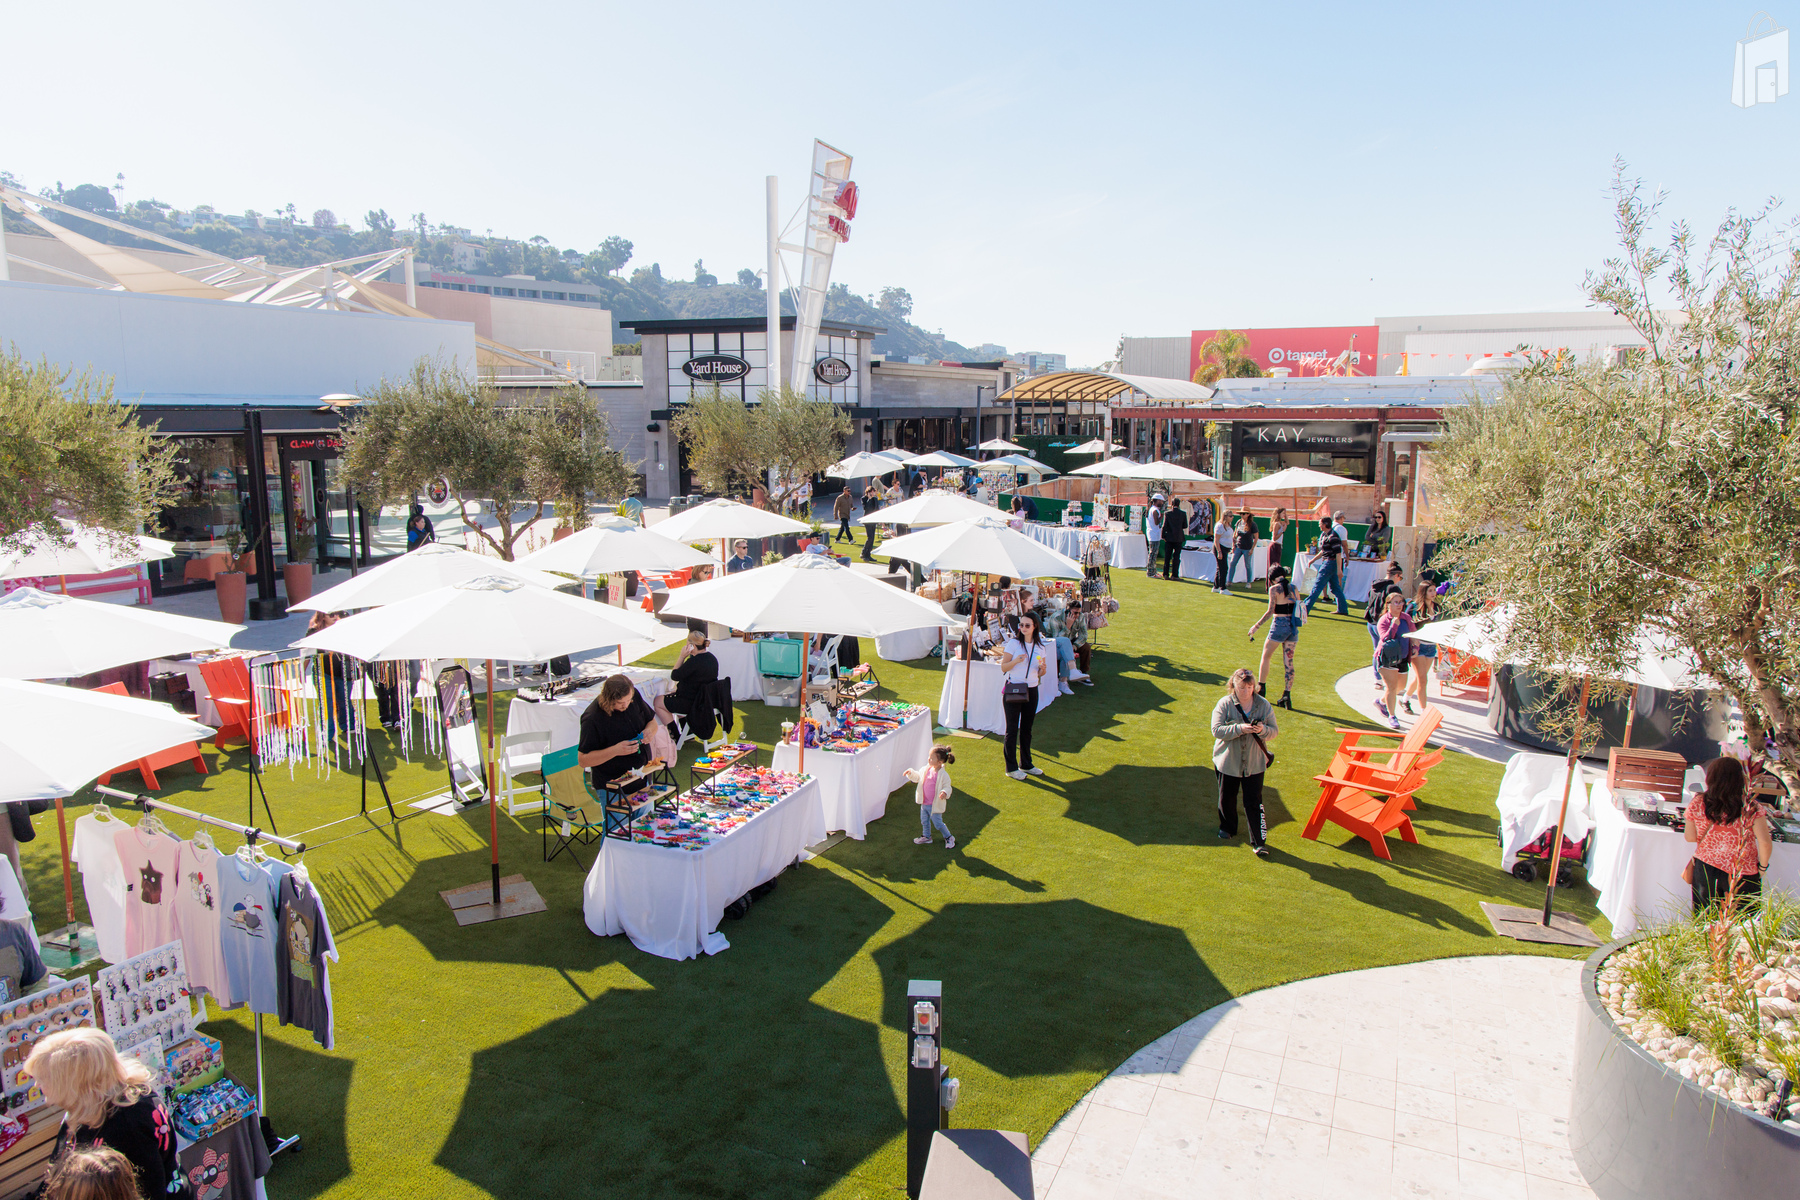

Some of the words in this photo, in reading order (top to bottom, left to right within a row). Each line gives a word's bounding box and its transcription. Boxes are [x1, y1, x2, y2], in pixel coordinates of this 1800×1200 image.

[431, 272, 476, 284] Sheraton
[1286, 349, 1328, 363] target
[688, 361, 711, 375] Yard
[712, 361, 742, 374] House
[822, 363, 834, 376] Yard
[834, 364, 849, 377] House
[1258, 427, 1304, 443] KAY
[290, 439, 315, 449] CLAW
